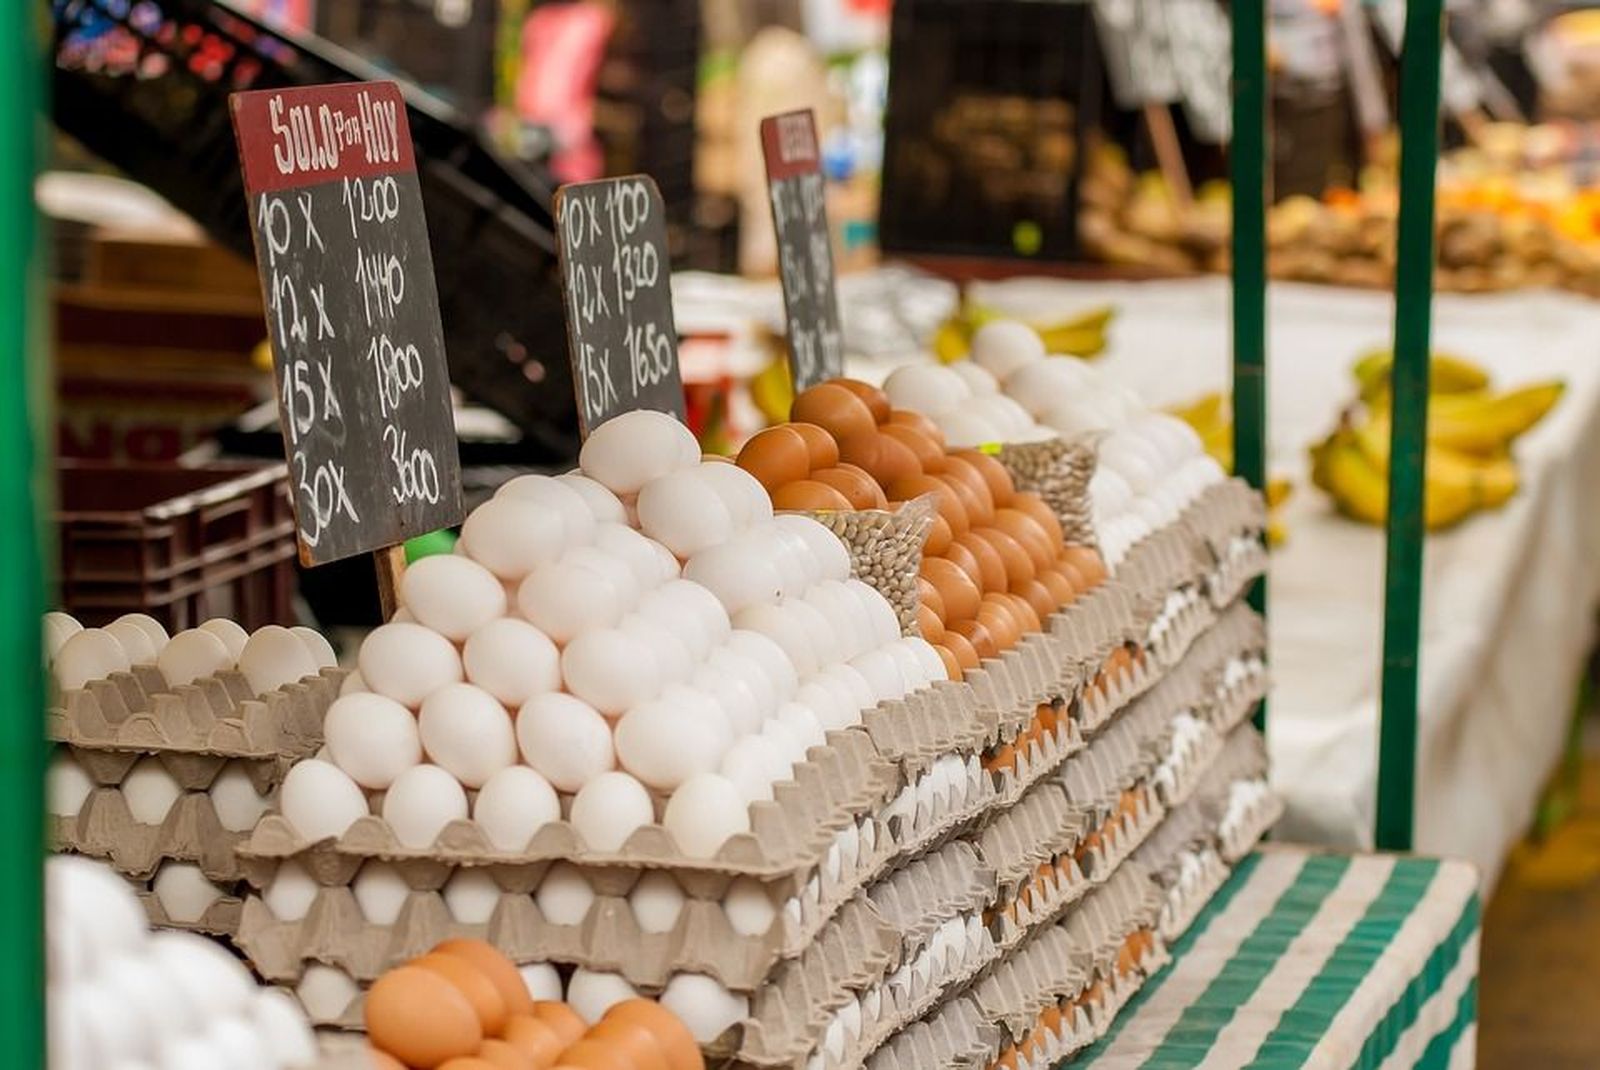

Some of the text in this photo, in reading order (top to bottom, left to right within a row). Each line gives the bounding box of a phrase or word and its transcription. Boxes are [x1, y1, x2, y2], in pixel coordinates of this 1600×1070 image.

[342, 176, 400, 239] 1200
[605, 179, 650, 248] 1100
[355, 247, 404, 328] 1440
[612, 241, 659, 316] 1320
[367, 333, 424, 419] 1800
[624, 322, 673, 398] 1650
[383, 424, 440, 505] 3600
